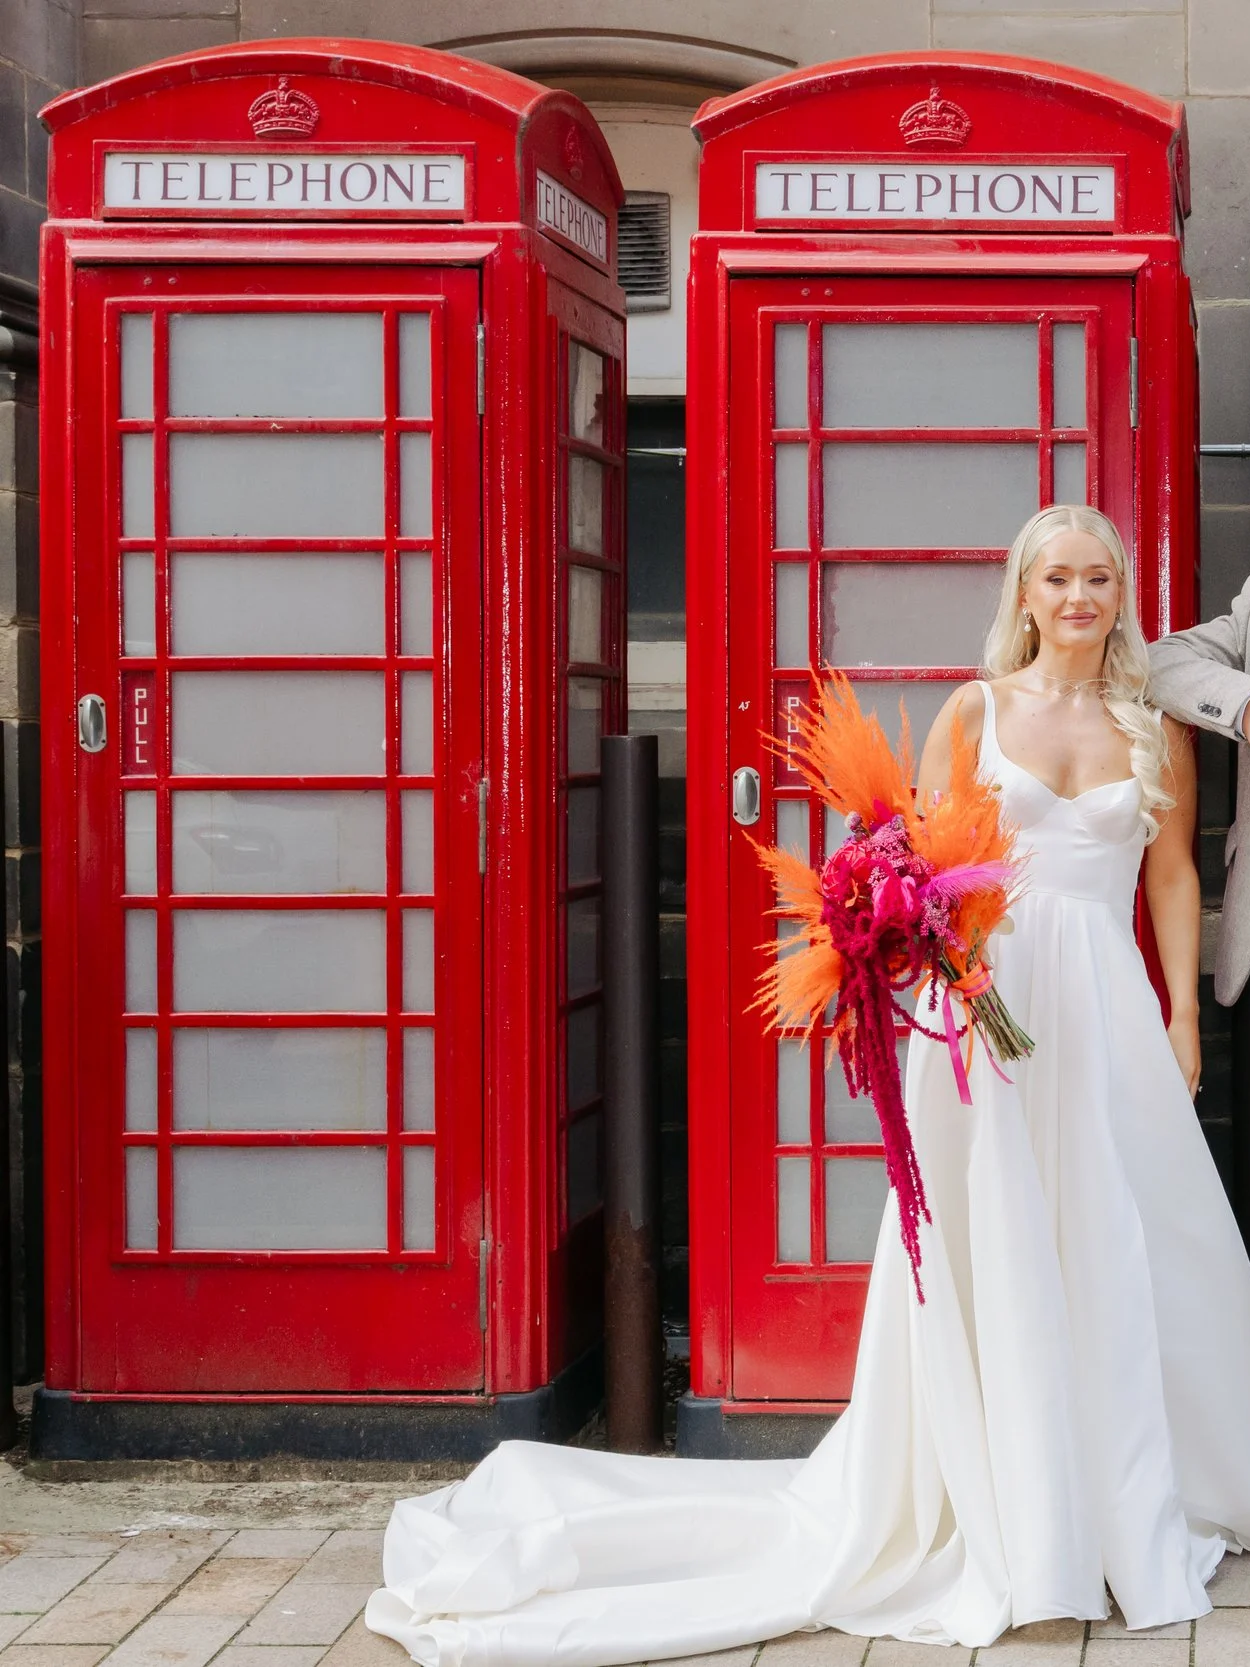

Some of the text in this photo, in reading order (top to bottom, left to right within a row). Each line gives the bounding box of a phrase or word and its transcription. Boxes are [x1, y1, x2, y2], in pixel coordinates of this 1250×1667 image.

[122, 162, 451, 202] TELEPHONE
[537, 177, 604, 260] TELEPHONE
[770, 172, 1100, 214] TELEPHONE
[134, 688, 148, 764] PULL
[787, 696, 800, 772] PULL
